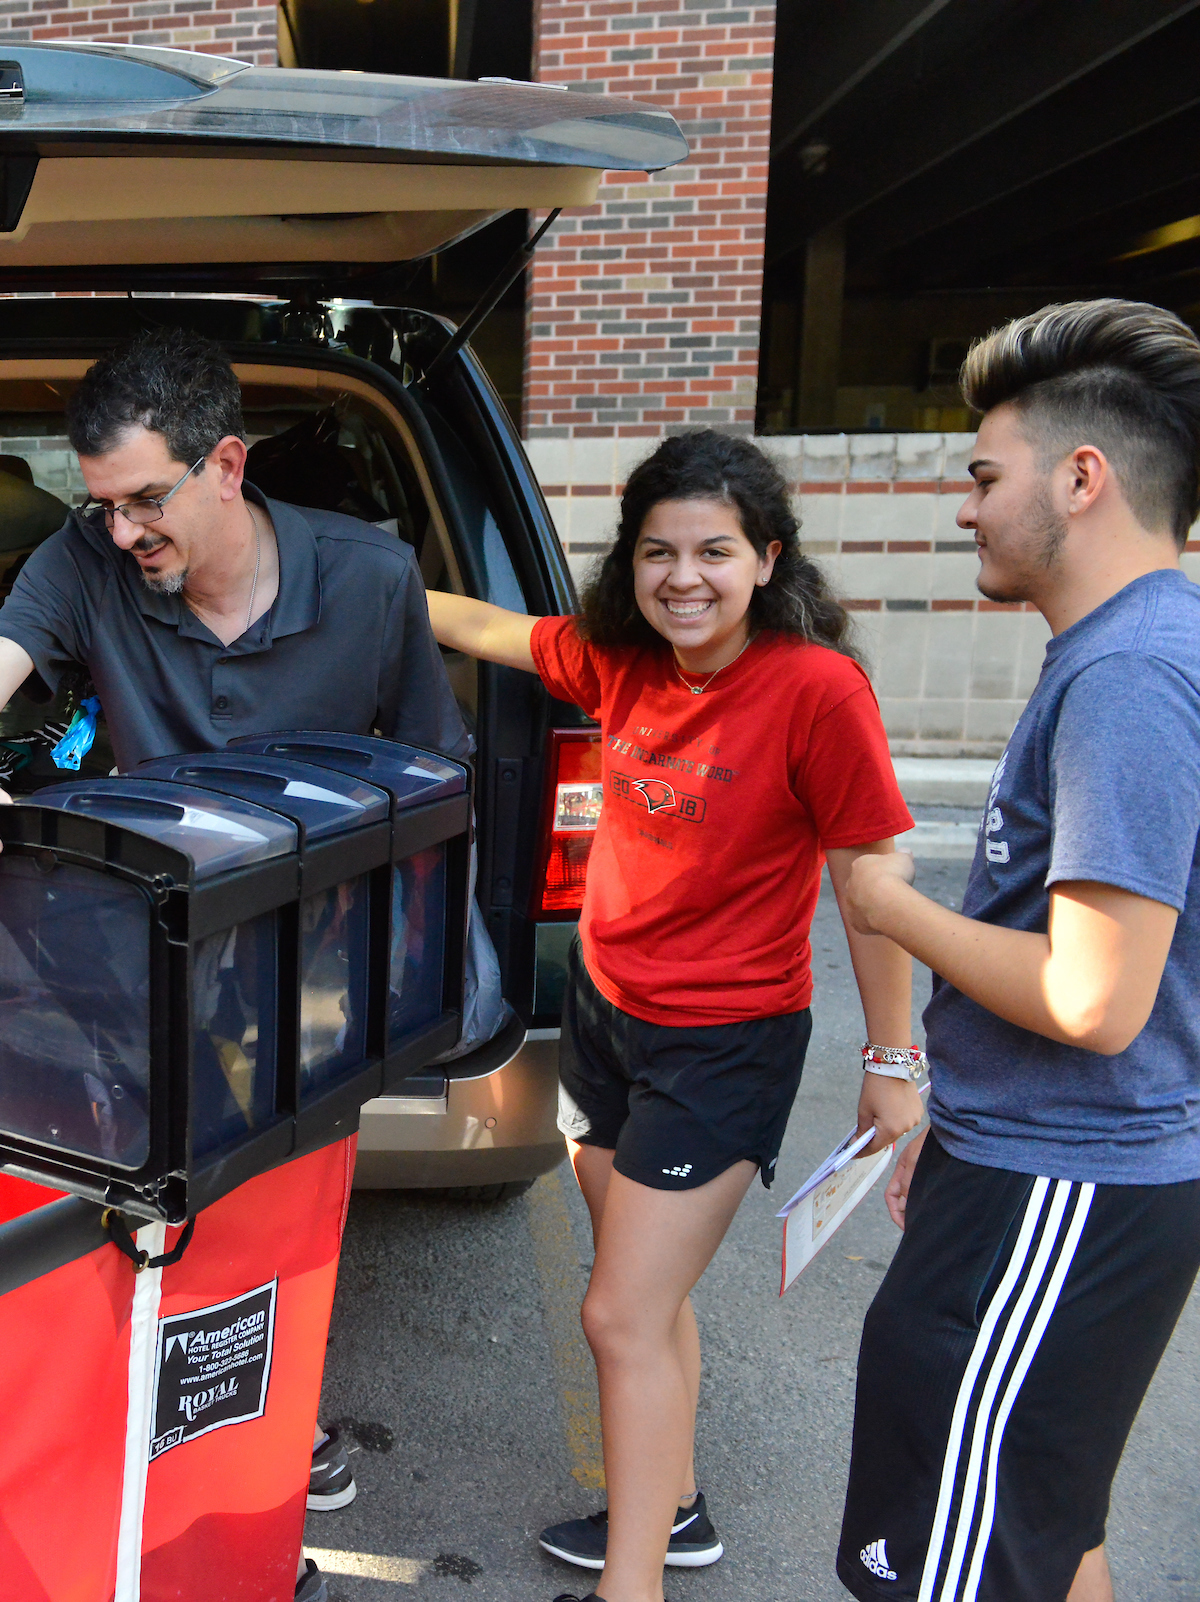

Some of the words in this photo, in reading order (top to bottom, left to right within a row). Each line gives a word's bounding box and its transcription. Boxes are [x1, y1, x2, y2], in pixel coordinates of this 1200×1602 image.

[633, 726, 703, 747] UNIVERSITY
[607, 735, 632, 754] THE
[631, 747, 694, 774] INCARNATE
[696, 763, 733, 782] WORD
[613, 777, 629, 795] 20
[679, 798, 697, 816] 18
[188, 1344, 210, 1355] HOTEL
[211, 1335, 238, 1349] REGISTER
[238, 1322, 265, 1340] COMPANY
[190, 1310, 266, 1346] American
[187, 1354, 209, 1365] Your
[211, 1347, 232, 1360] Total
[233, 1333, 265, 1351] Solution
[180, 1353, 263, 1385] www.americanhotel.com
[178, 1377, 240, 1422] ROYAL
[193, 1400, 215, 1414] BASKET
[215, 1389, 237, 1403] TRUCKS
[860, 1548, 898, 1581] adidas
